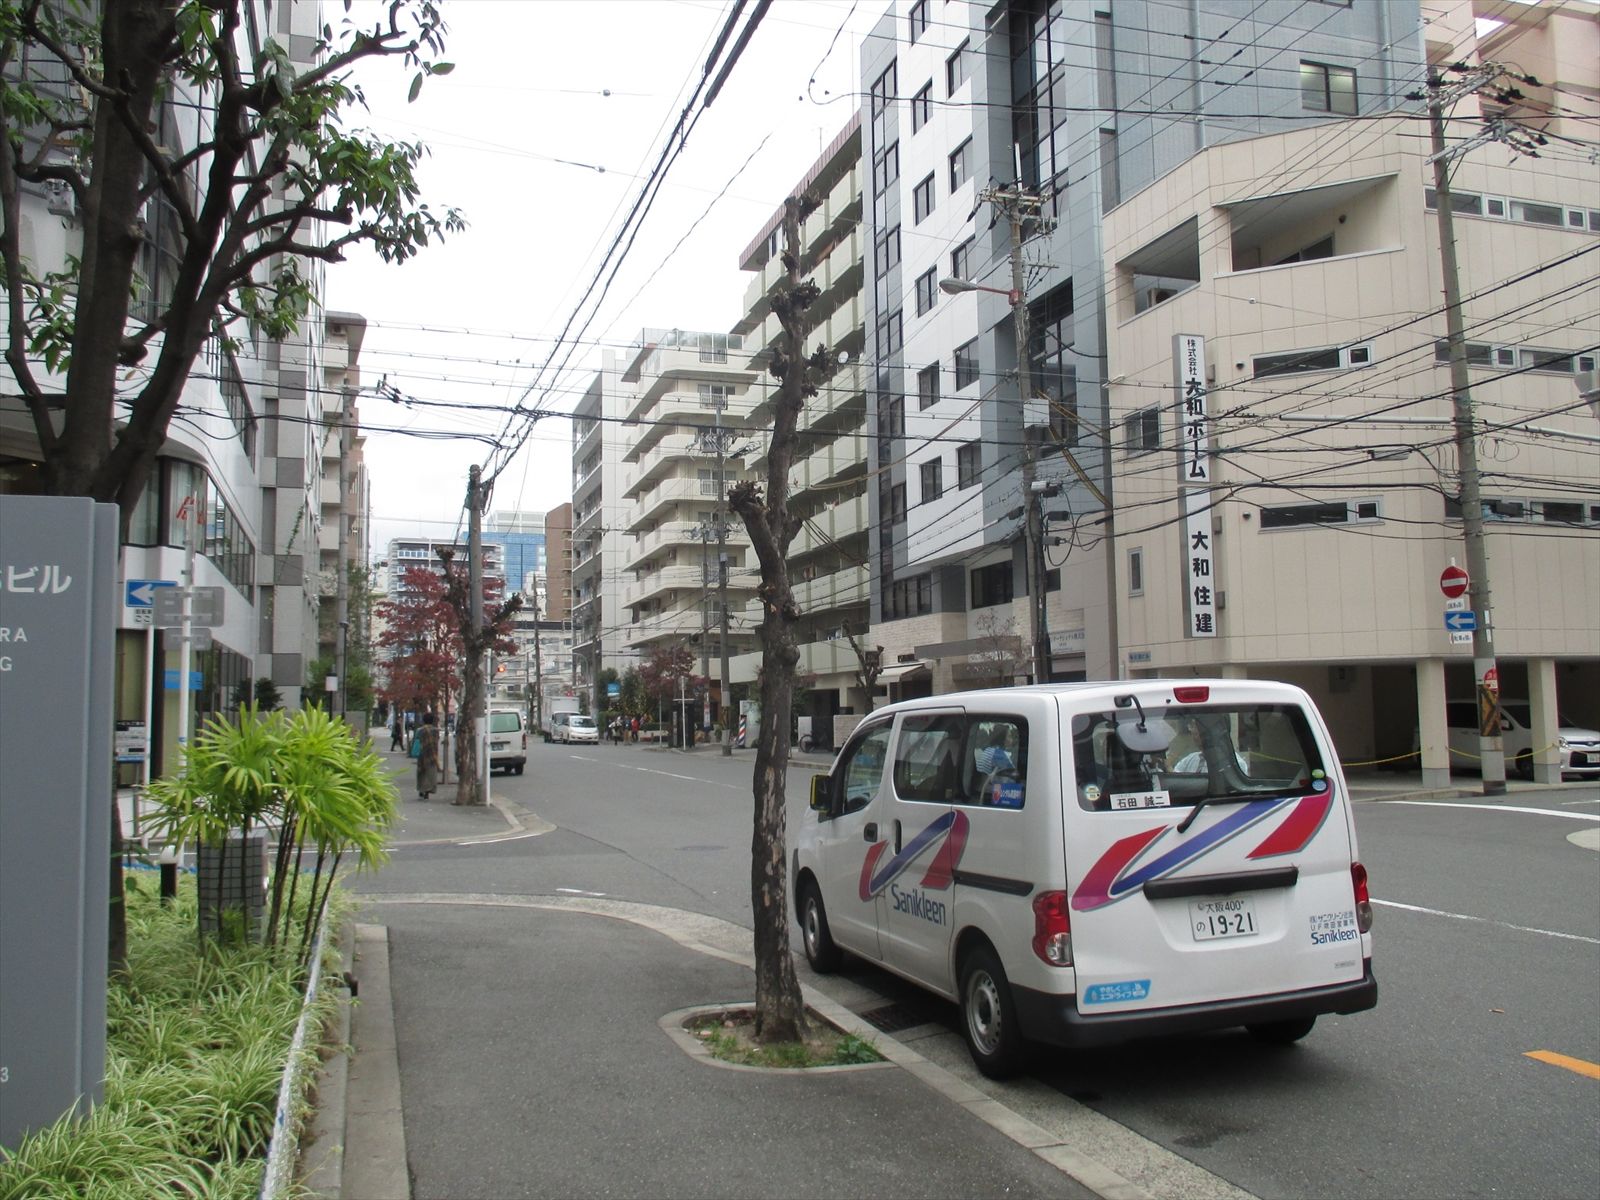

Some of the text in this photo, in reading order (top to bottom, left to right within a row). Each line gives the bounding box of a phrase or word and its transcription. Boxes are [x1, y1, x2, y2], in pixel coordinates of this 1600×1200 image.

[0, 565, 73, 594] ビル
[1191, 530, 1213, 633] 大和住建
[891, 883, 946, 926] Sanikleen
[1196, 912, 1254, 936] の 19-21
[1311, 930, 1358, 945] Sanikleen
